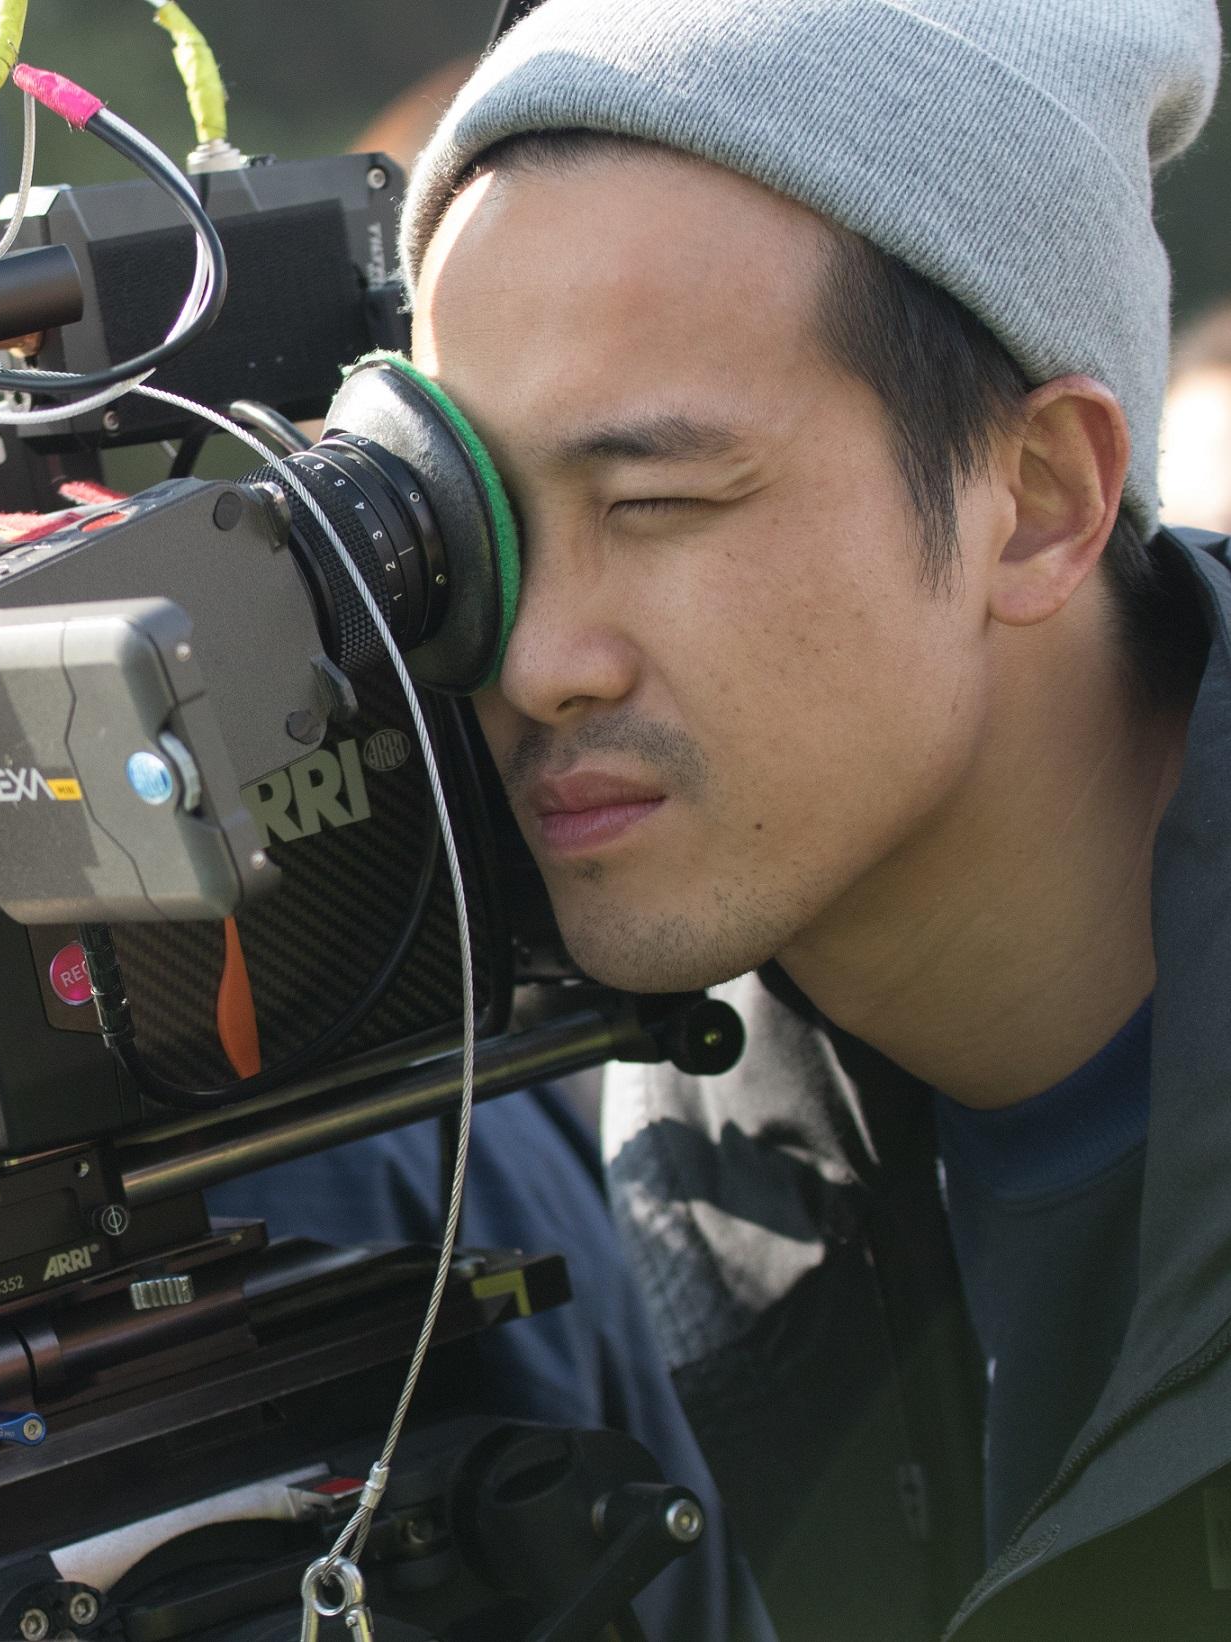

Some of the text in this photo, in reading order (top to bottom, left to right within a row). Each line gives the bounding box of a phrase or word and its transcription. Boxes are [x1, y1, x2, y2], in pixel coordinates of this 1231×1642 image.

[334, 478, 346, 488] 5
[354, 501, 365, 510] 4
[372, 530, 383, 540] 3
[385, 561, 396, 571] 2
[240, 738, 371, 848] RRI
[42, 1246, 93, 1282] ARRI
